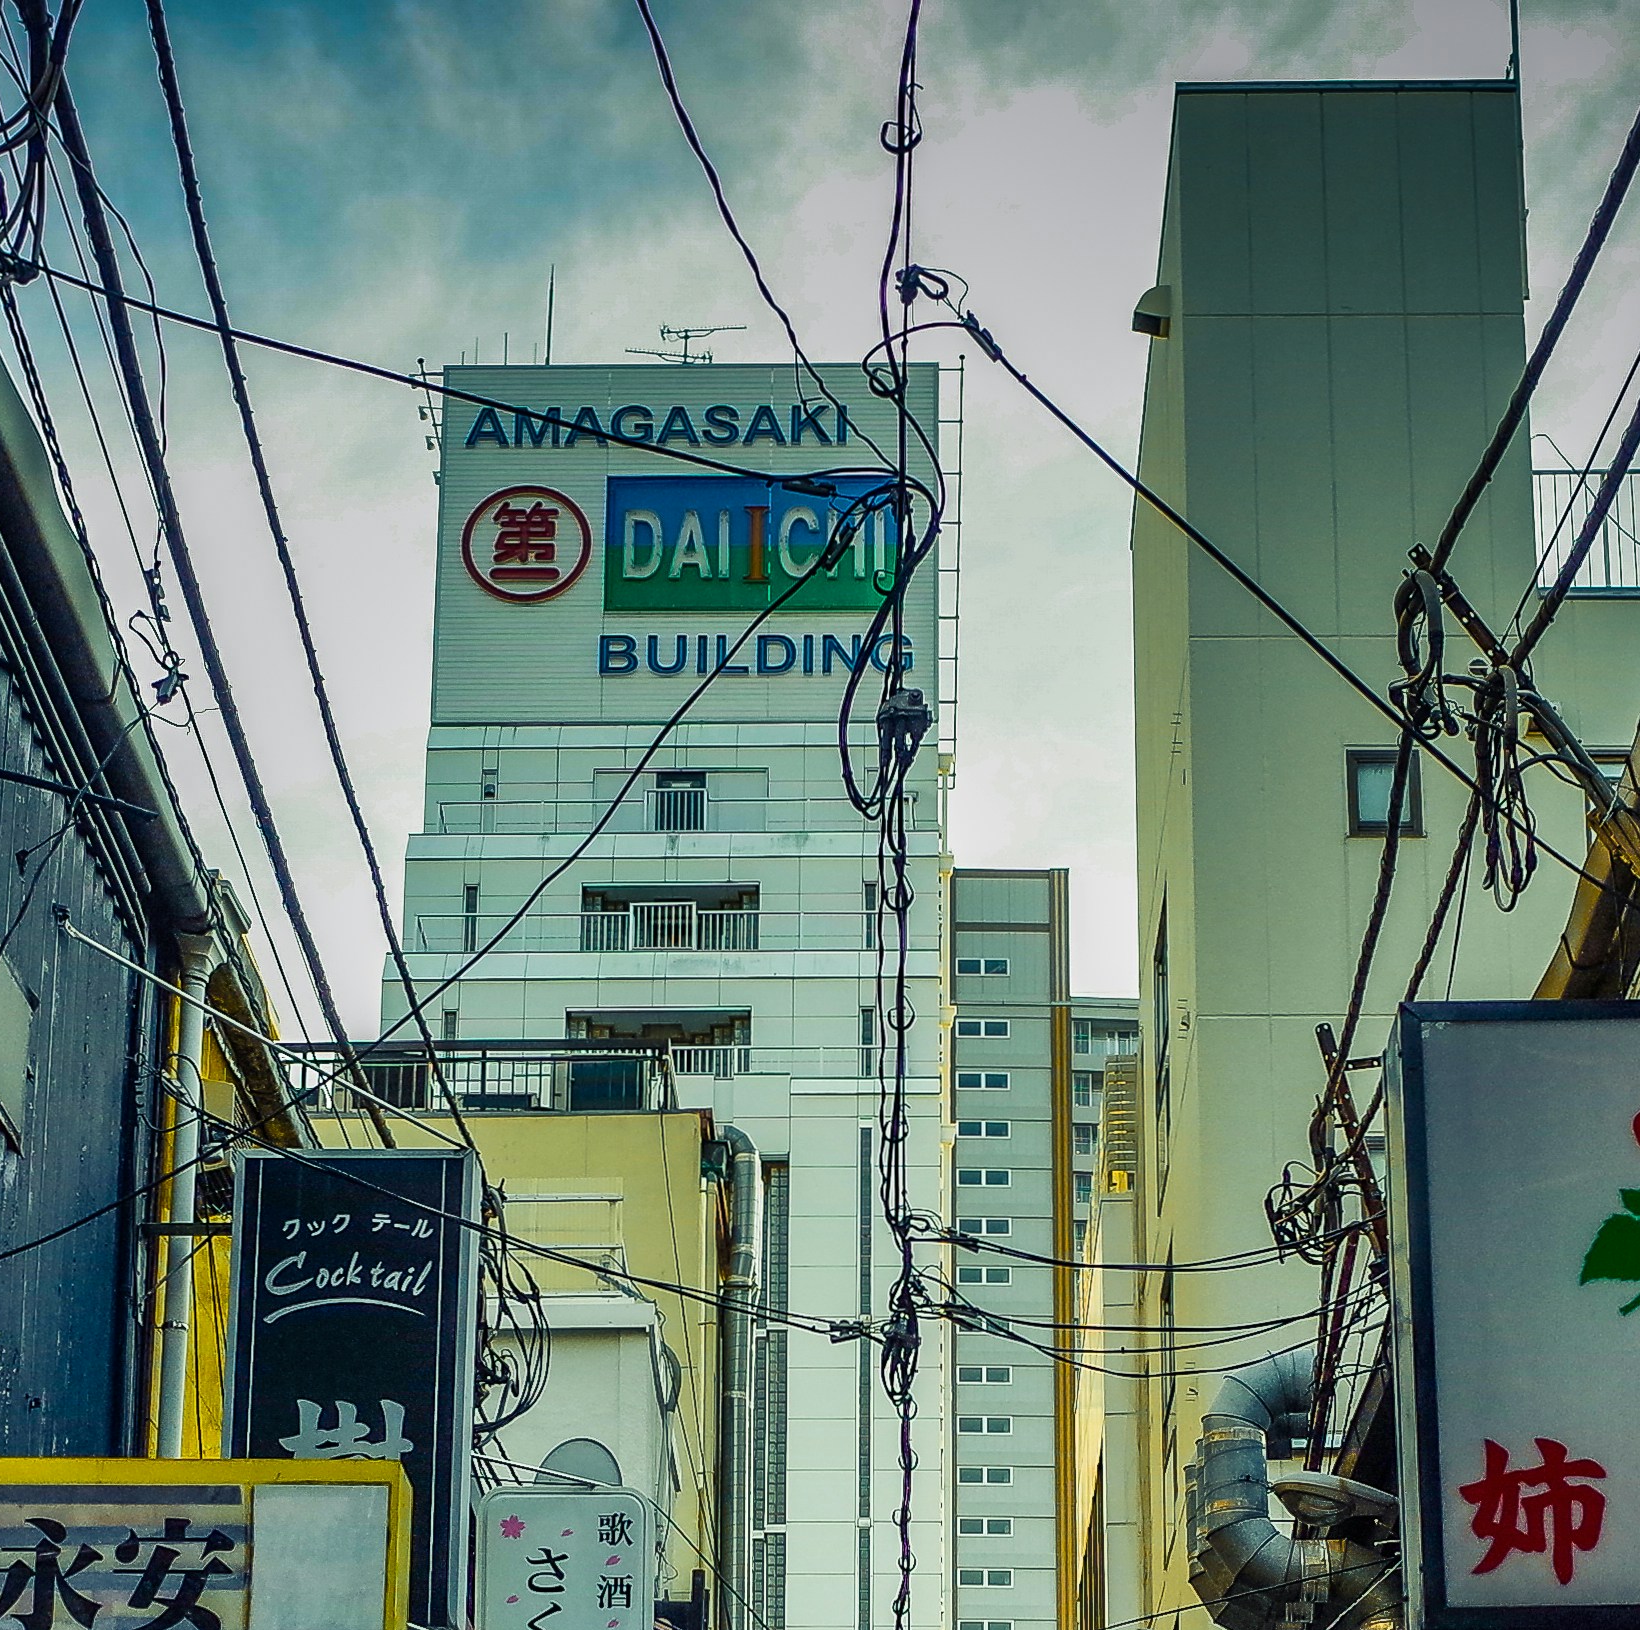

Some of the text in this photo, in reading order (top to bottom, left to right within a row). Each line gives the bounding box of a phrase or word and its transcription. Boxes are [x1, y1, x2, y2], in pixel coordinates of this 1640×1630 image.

[464, 404, 850, 448] AMAGASAKI
[622, 506, 887, 582] DAIICHI
[599, 632, 914, 676] BUILDING
[371, 1213, 434, 1239] テール
[598, 1512, 634, 1546] 歌
[597, 1574, 633, 1609] 酒
